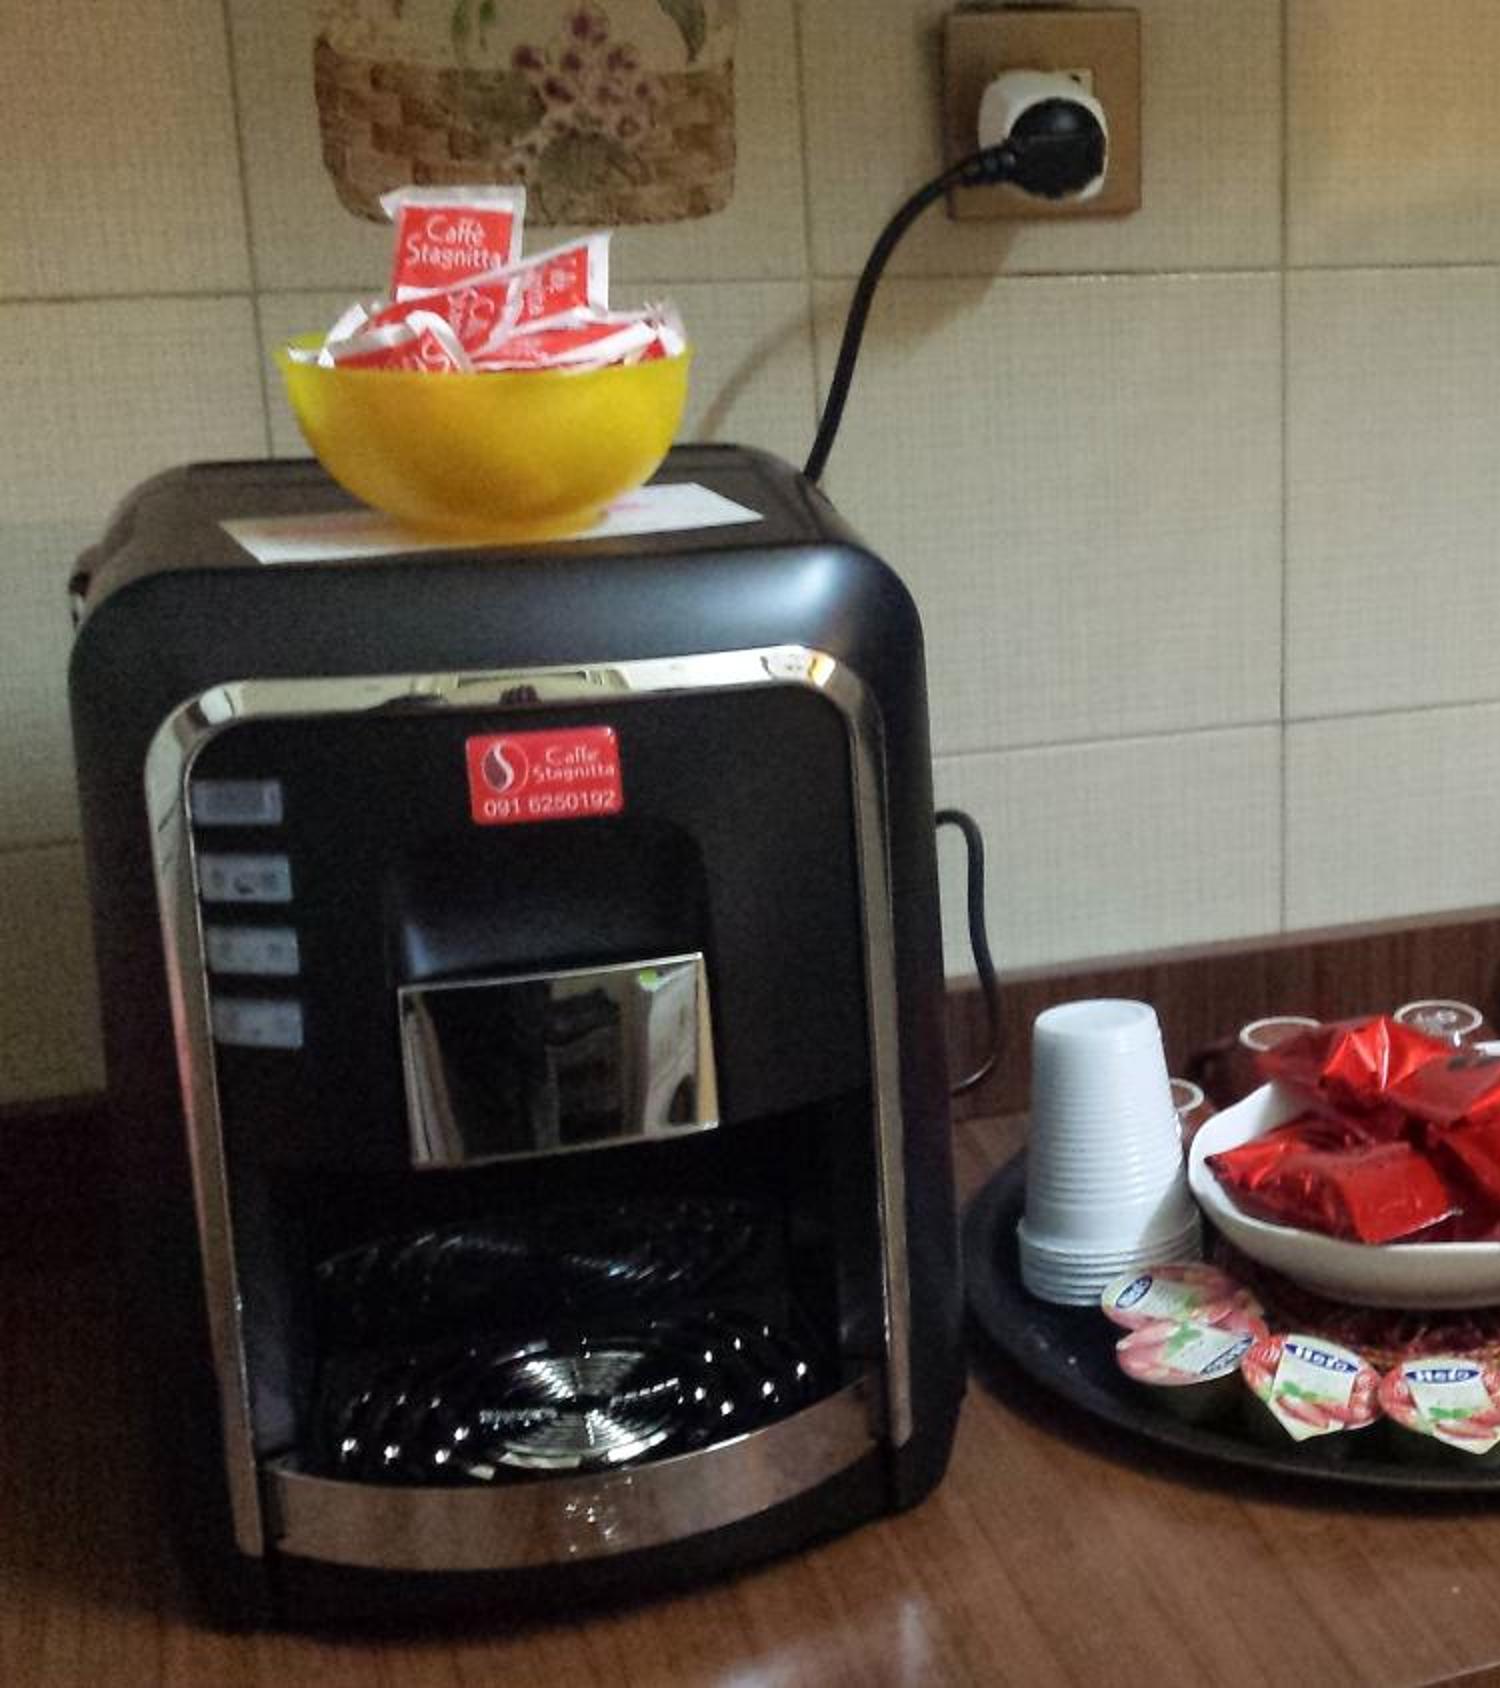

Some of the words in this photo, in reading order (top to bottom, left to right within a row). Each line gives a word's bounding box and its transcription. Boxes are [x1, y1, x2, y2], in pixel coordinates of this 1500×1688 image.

[533, 763, 615, 784] Stagnitta
[484, 797, 520, 817] 091
[528, 790, 616, 814] 6250192
